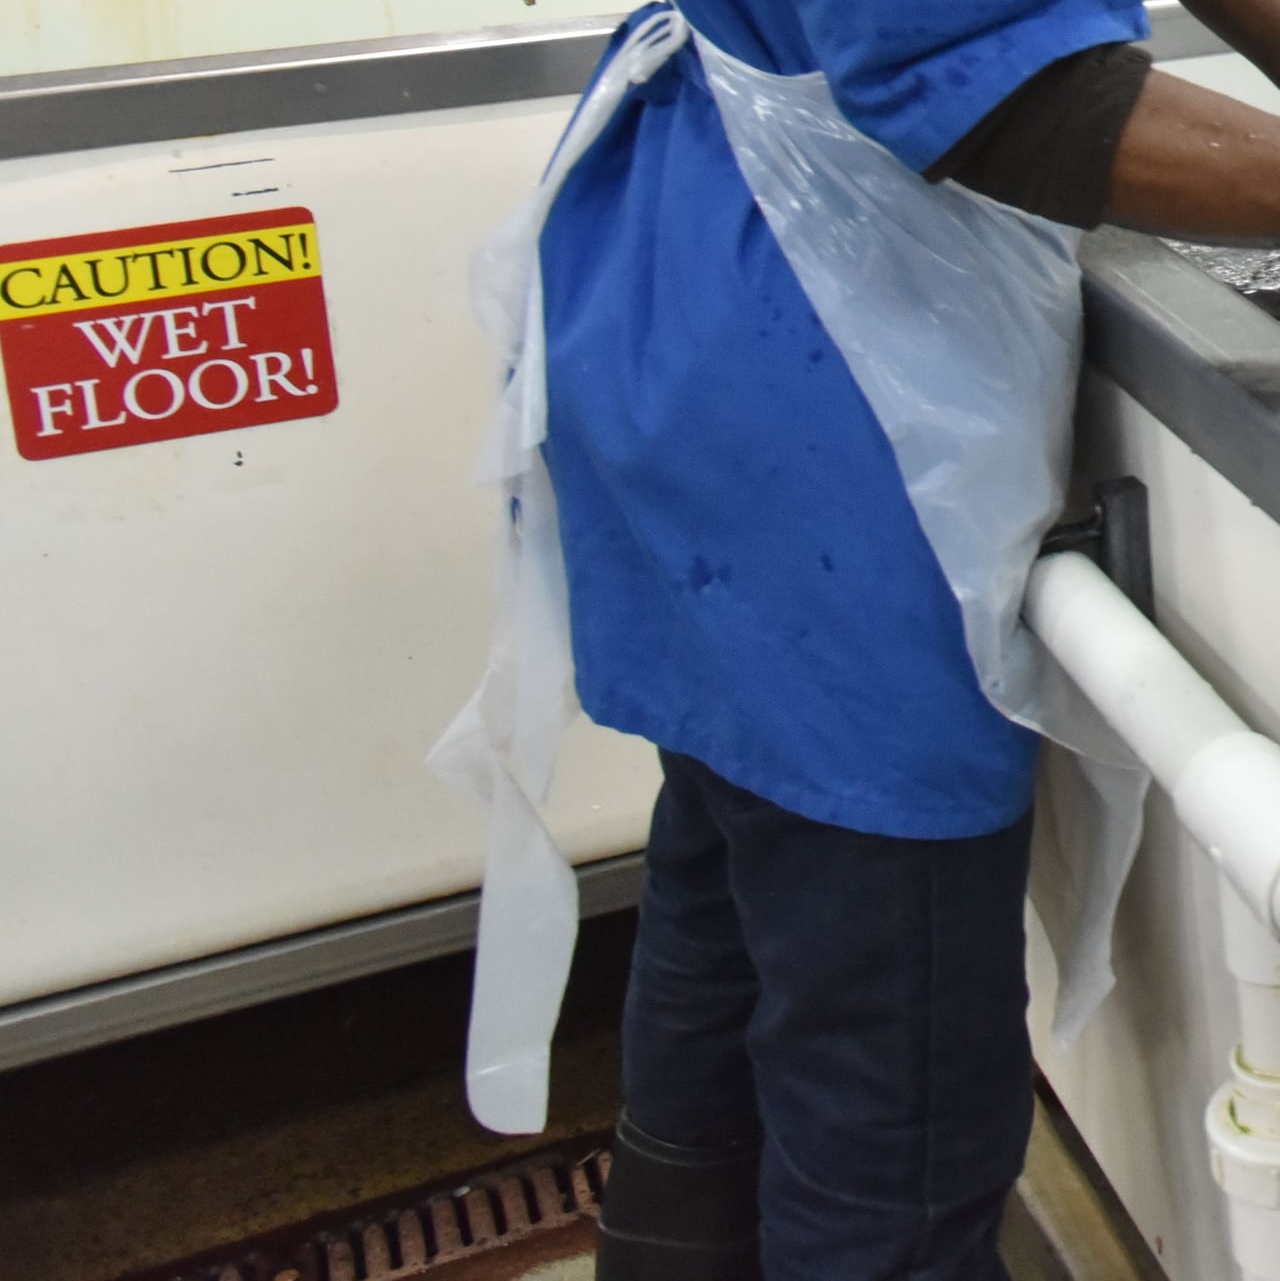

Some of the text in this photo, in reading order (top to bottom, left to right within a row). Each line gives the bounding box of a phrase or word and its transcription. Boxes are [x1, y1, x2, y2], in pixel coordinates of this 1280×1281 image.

[1, 233, 312, 309] CAUTION!
[72, 296, 256, 368] WET
[30, 348, 319, 437] FLOOR!
